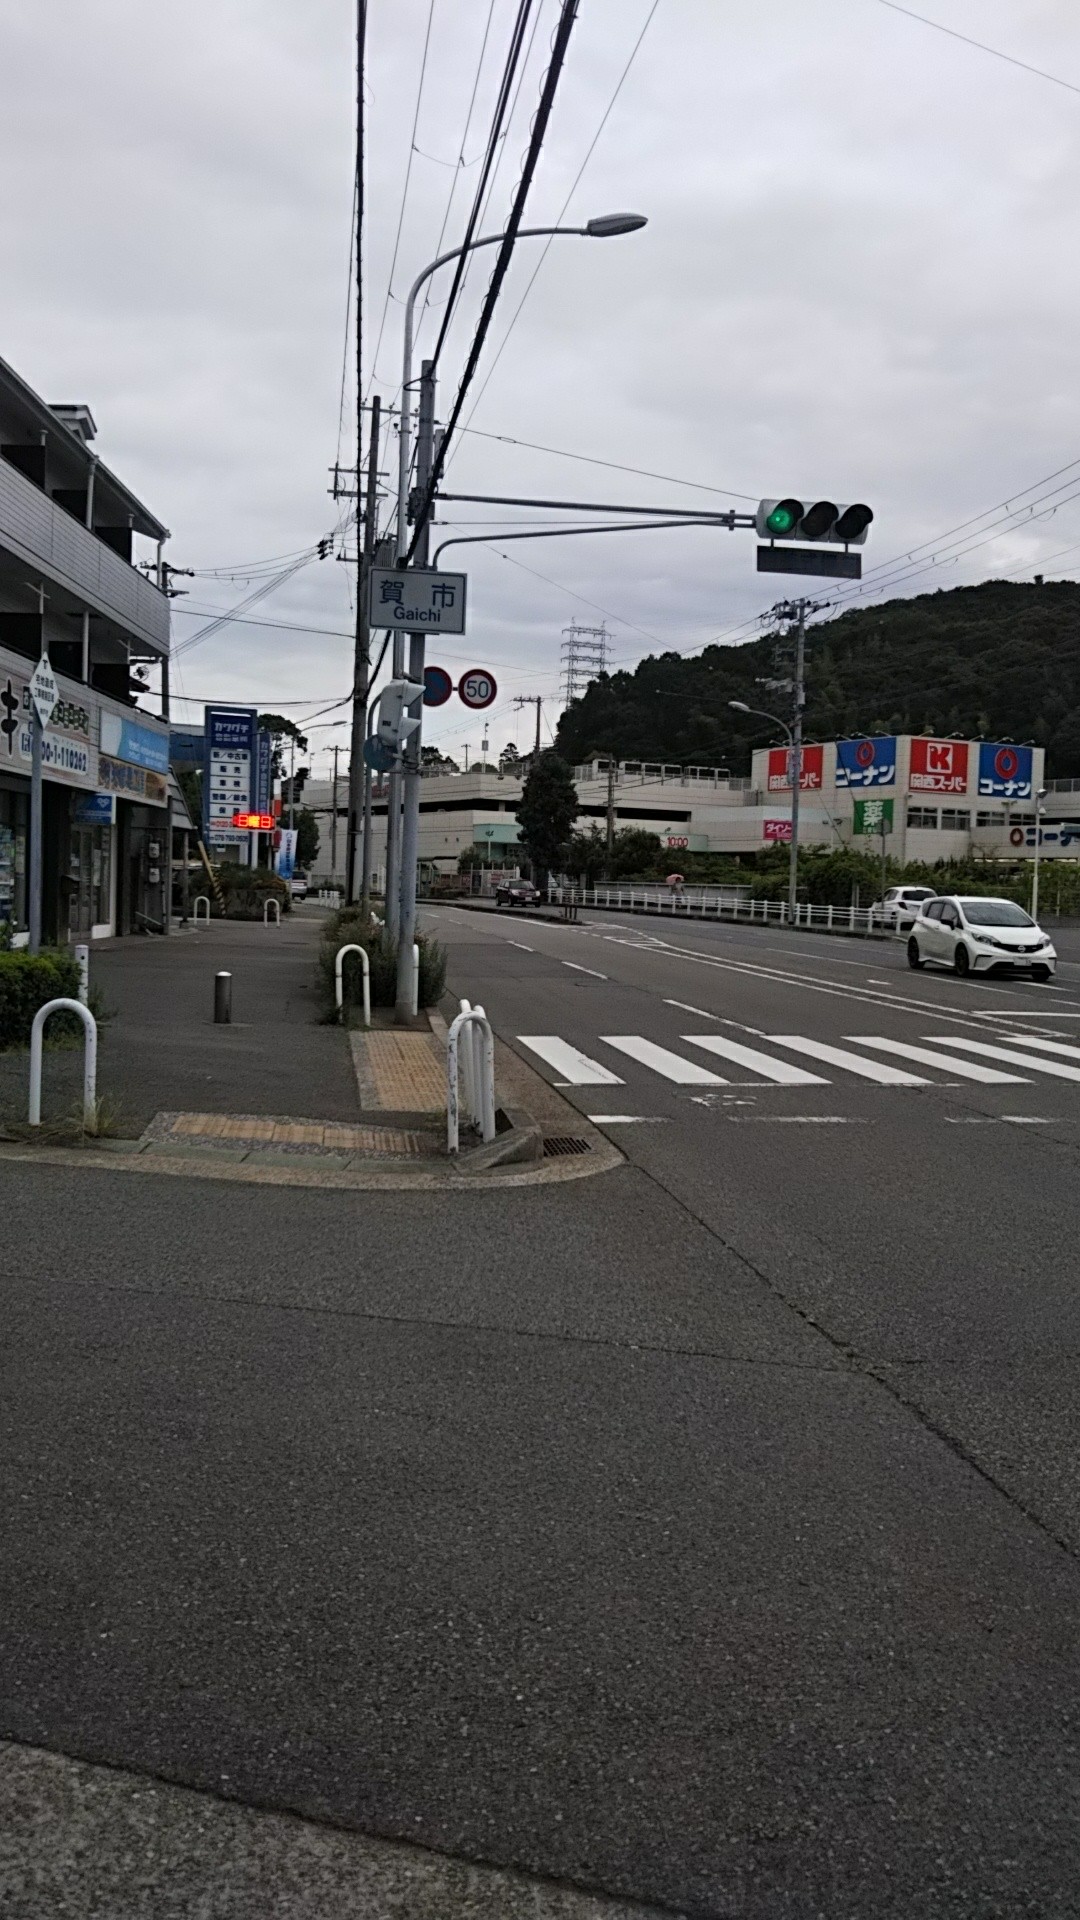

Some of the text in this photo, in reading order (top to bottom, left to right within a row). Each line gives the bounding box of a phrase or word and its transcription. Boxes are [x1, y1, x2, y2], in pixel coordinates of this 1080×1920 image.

[379, 580, 456, 608] 賀市
[393, 607, 442, 622] Gaichi
[466, 680, 489, 698] 50
[215, 722, 250, 733] カワグチ
[769, 772, 820, 791] 関西ーパー
[835, 765, 895, 787] コーナン
[910, 773, 967, 792] 関西スーパー
[979, 778, 1031, 797] コーナン
[863, 801, 884, 827] 薬
